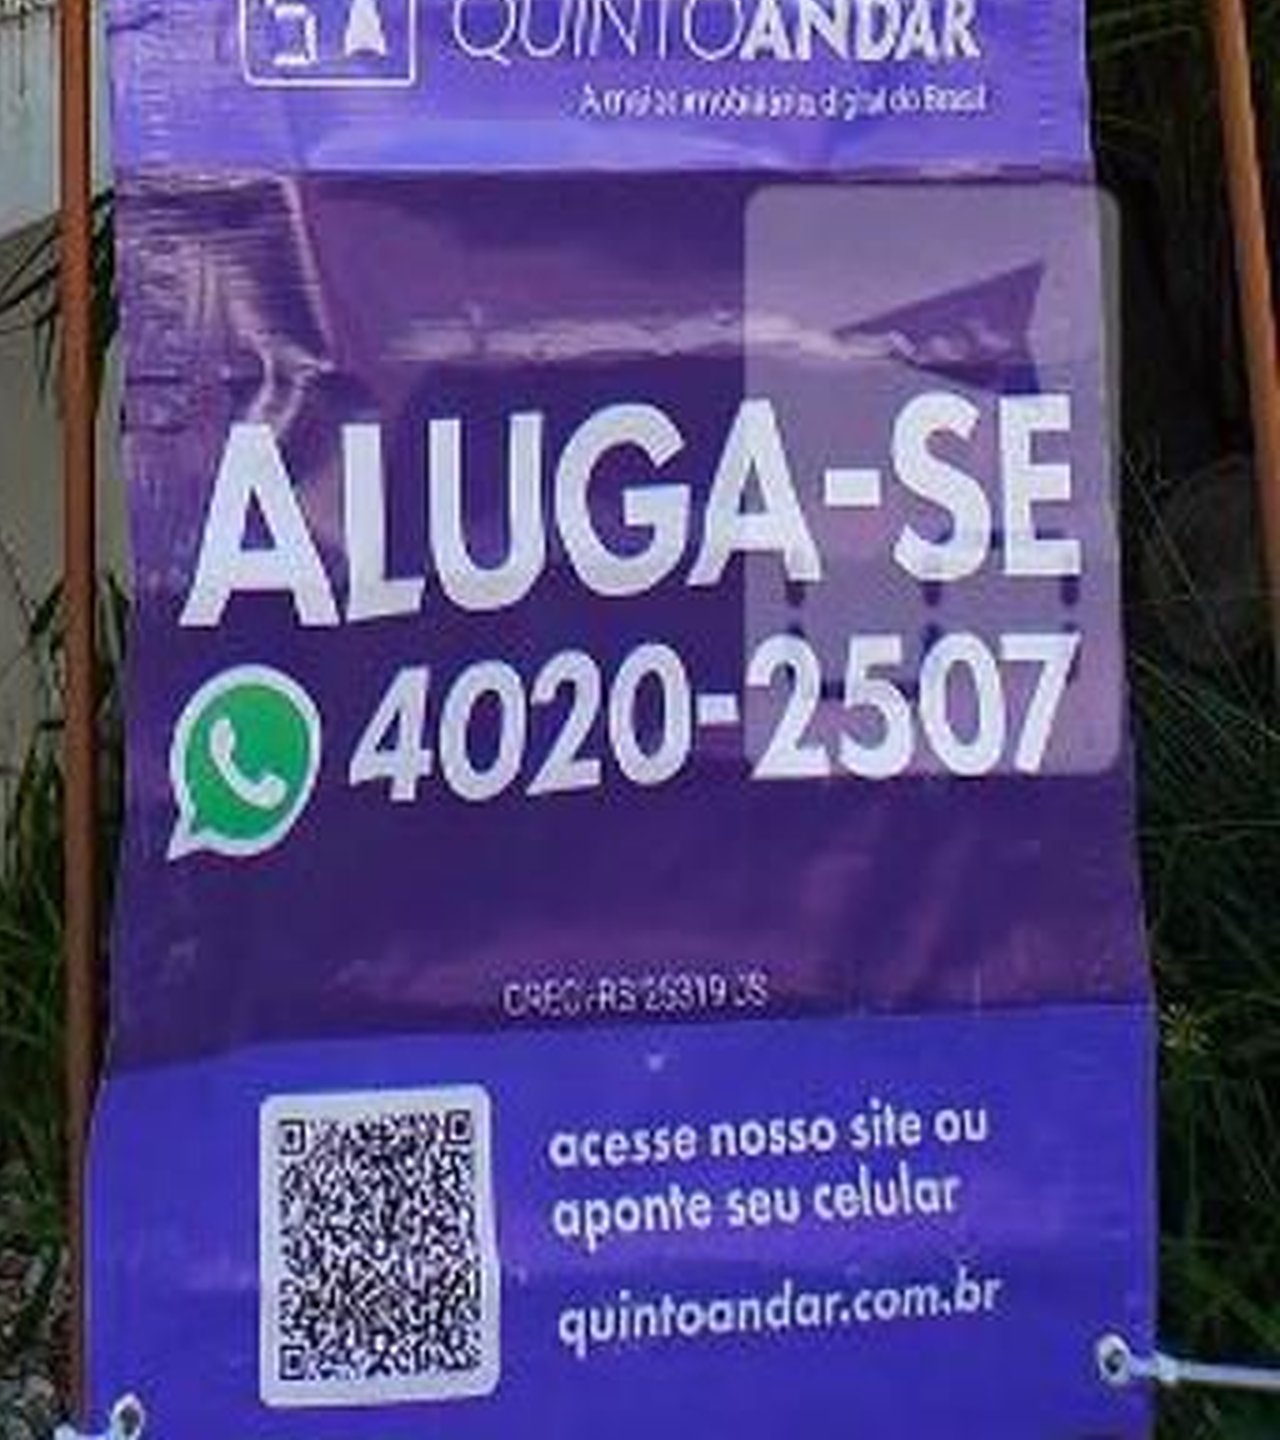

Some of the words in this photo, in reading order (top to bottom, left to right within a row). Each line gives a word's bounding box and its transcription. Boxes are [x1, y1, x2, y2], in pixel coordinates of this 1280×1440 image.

[180, 392, 1082, 628] ALUGA-SE
[348, 631, 1082, 804] 4020-2507
[548, 1124, 697, 1168] acesse
[708, 1116, 837, 1160] nosso
[848, 1099, 922, 1150] site
[934, 1104, 989, 1144] ou
[552, 1183, 713, 1251] aponte
[725, 1180, 801, 1223] seu
[812, 1161, 962, 1222] celular
[558, 1267, 1002, 1357] quintoandar.com.br
